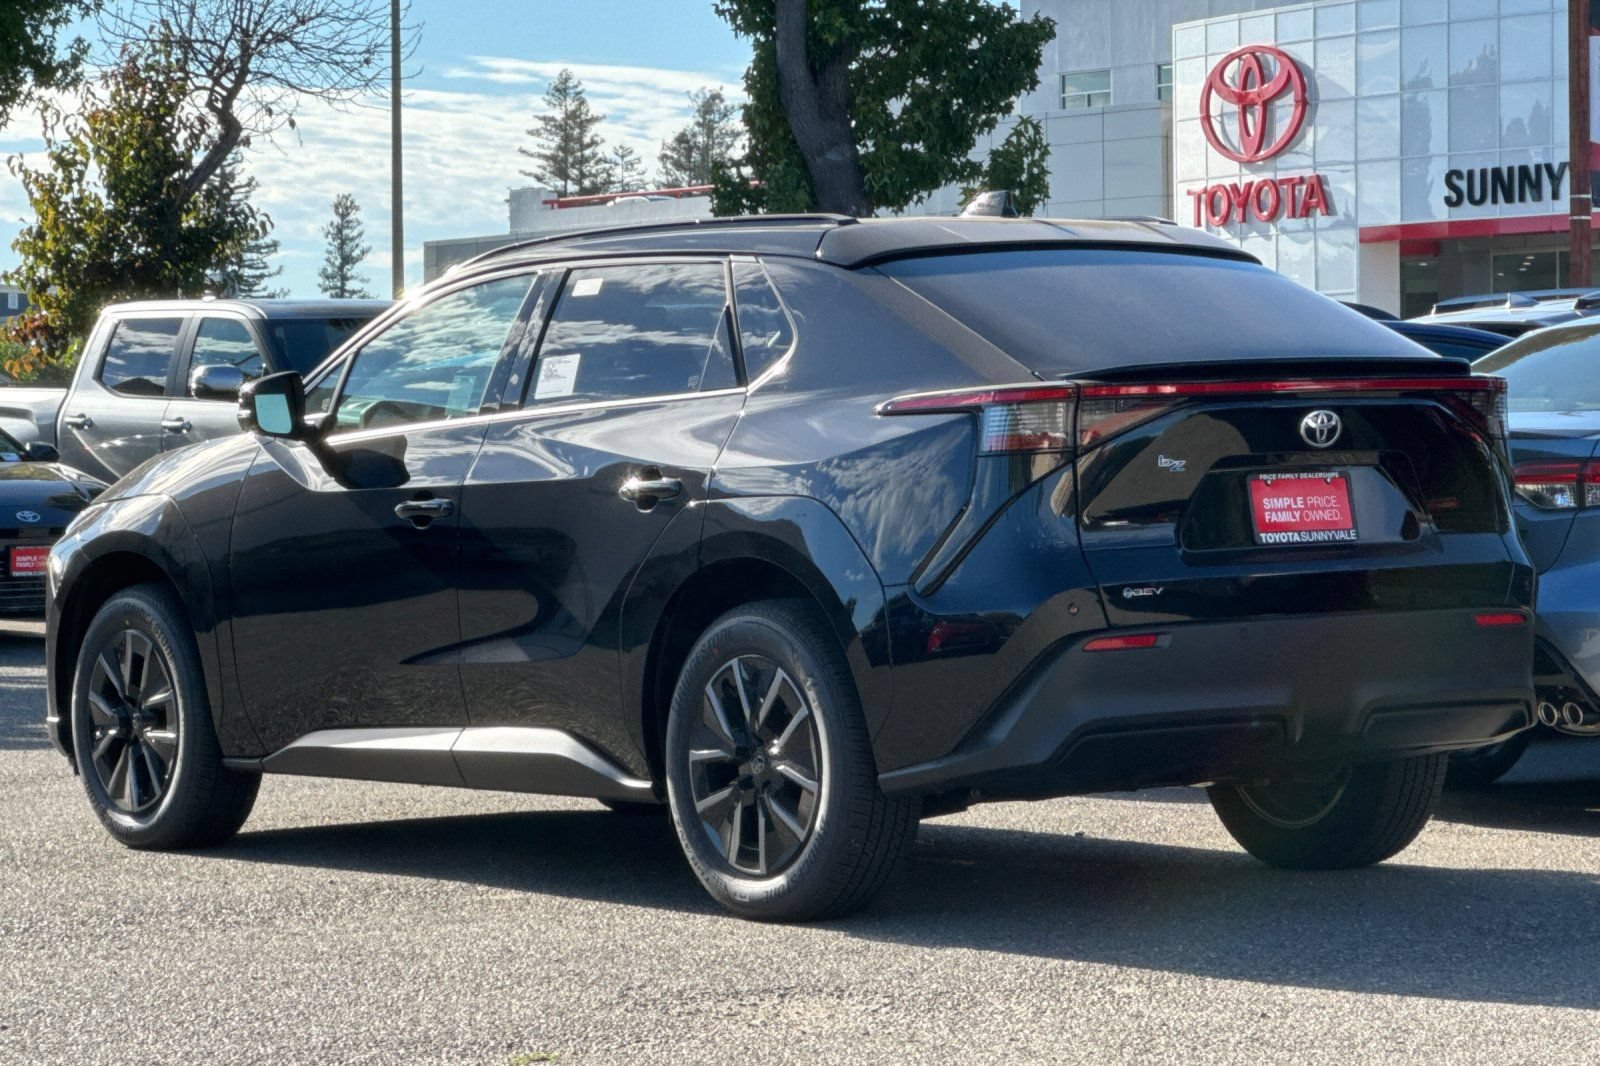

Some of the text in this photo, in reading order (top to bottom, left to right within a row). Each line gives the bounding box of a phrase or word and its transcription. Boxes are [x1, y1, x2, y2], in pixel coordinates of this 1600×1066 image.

[1444, 161, 1569, 207] SUNNY
[1187, 174, 1330, 228] TOYOTA
[1263, 496, 1341, 509] SIMPLE PRICE.
[1264, 509, 1344, 523] FAMILY OWNED.
[1260, 530, 1357, 543] TOYOTA SUNNYVALE
